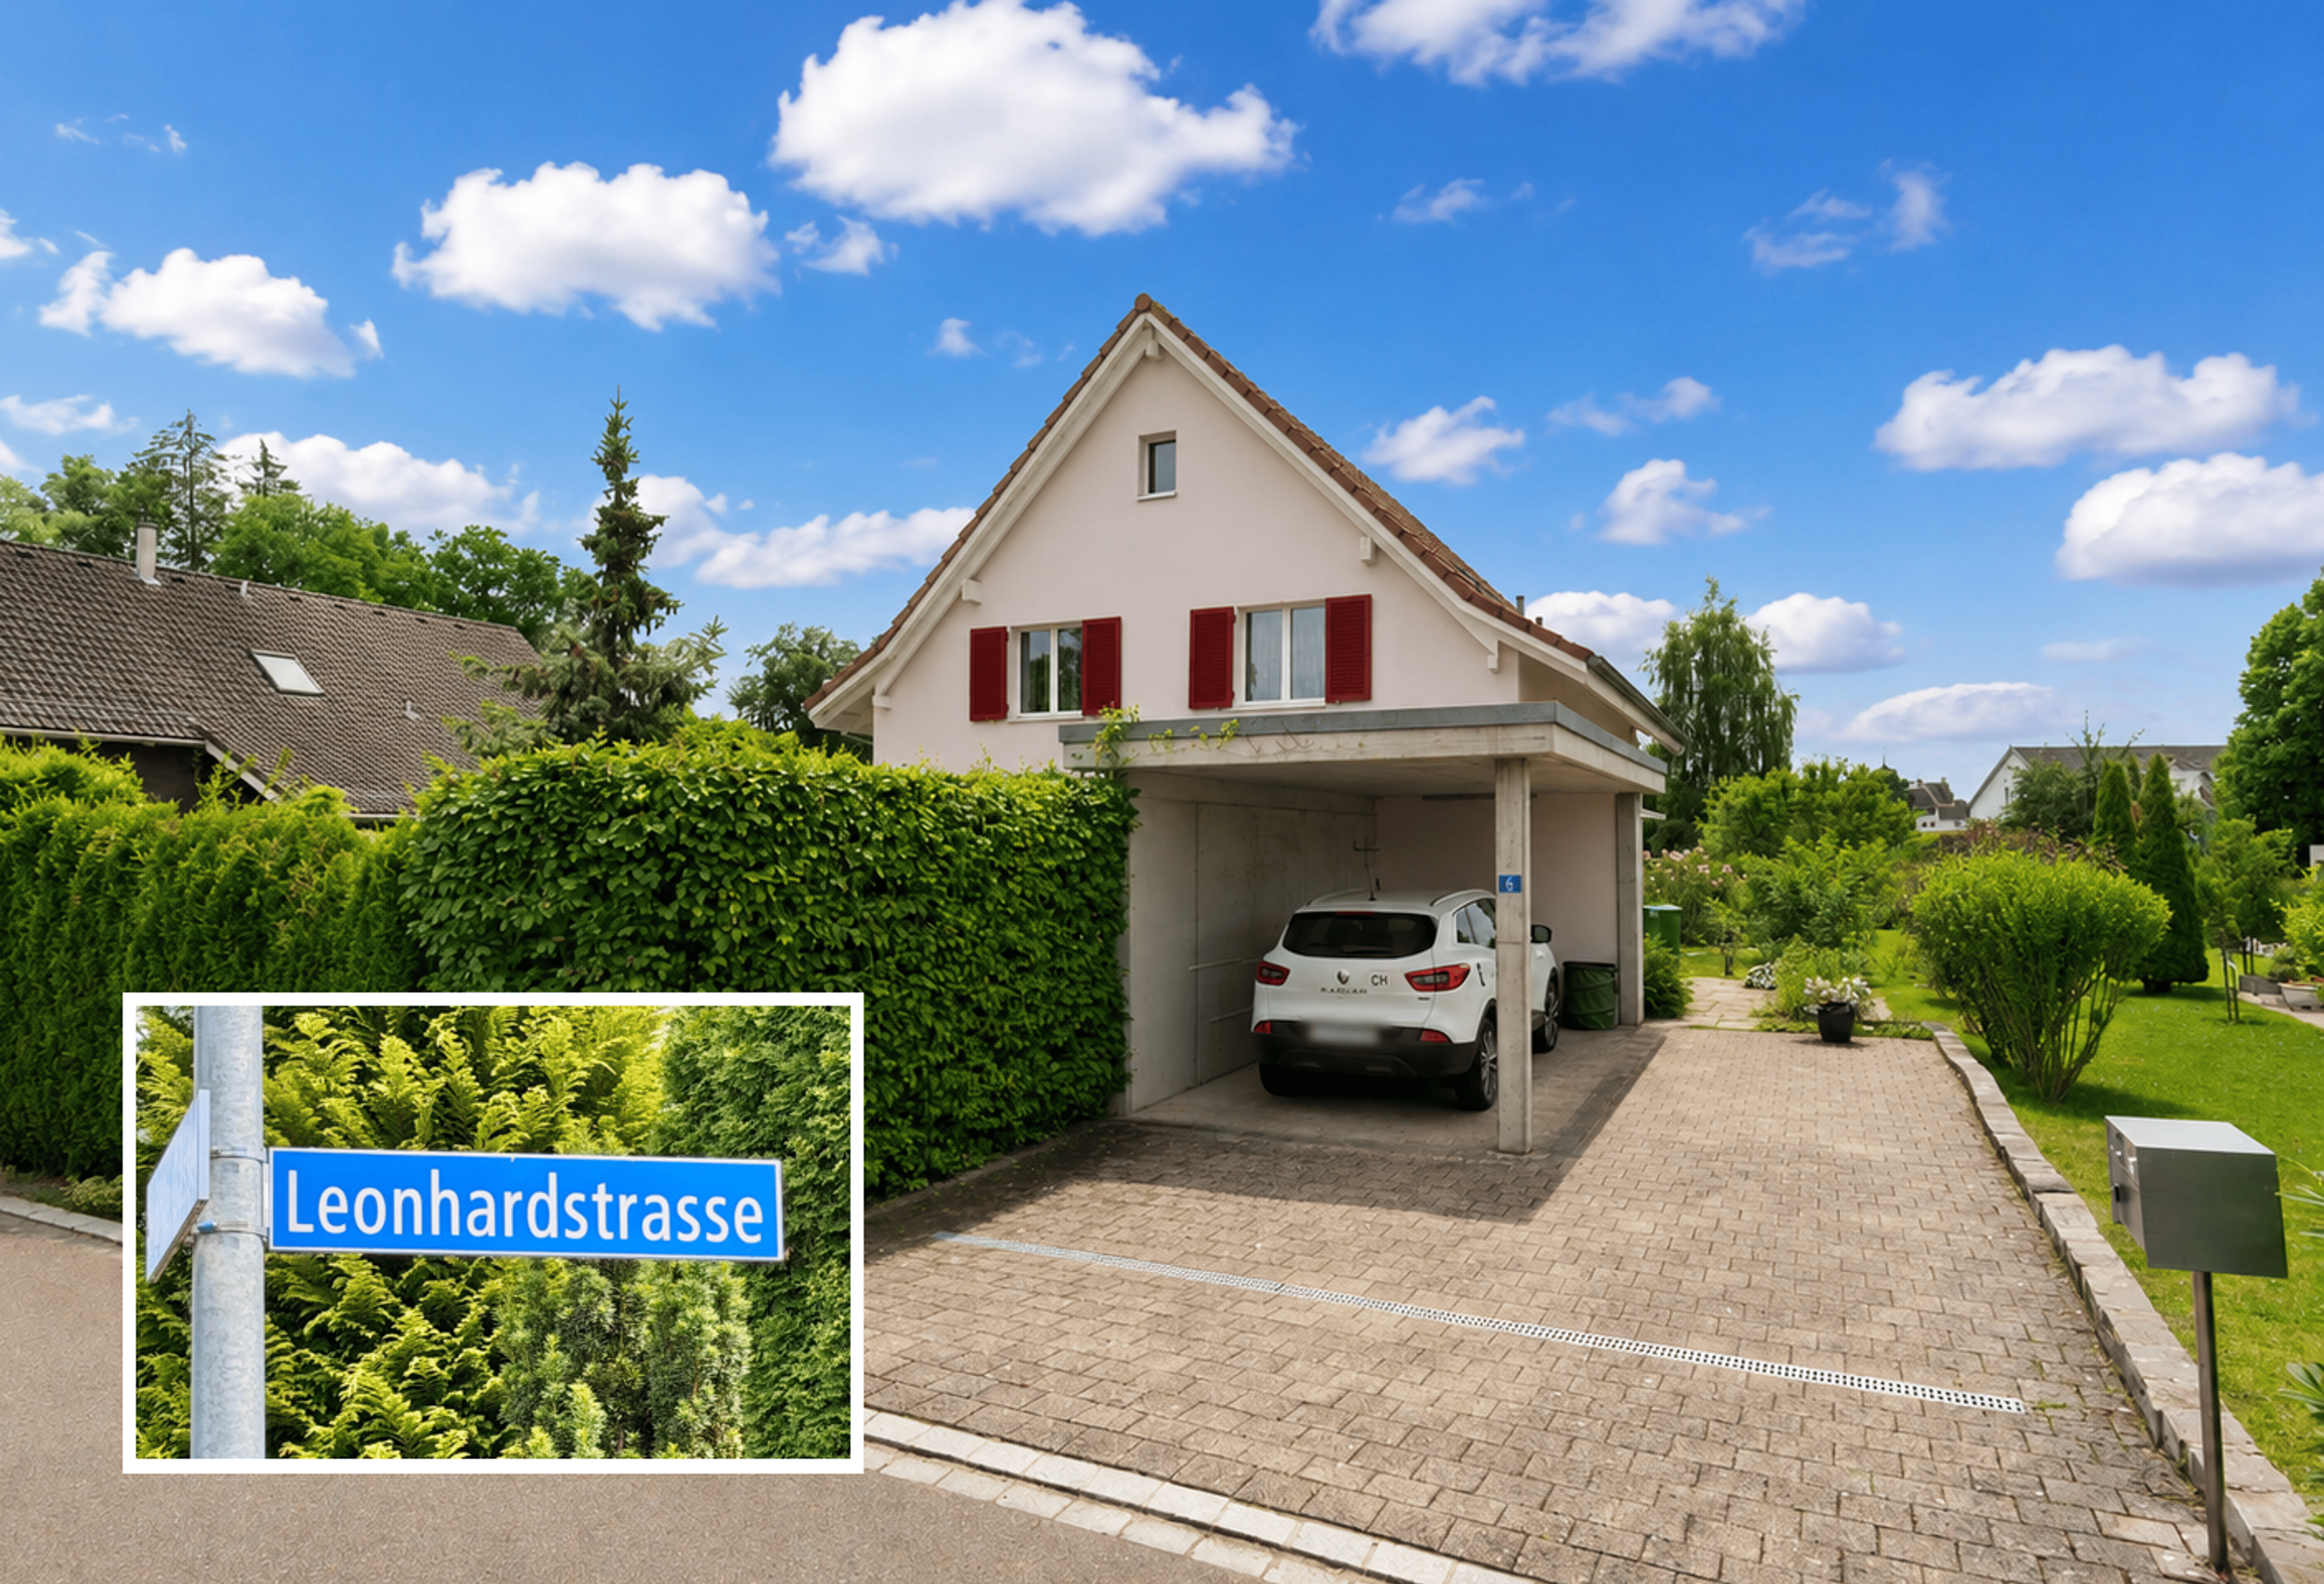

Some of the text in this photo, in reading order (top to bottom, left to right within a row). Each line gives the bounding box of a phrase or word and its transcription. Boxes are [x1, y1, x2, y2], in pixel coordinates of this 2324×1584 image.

[1505, 875, 1514, 892] 6
[1371, 974, 1388, 986] CH
[289, 1169, 763, 1243] Leonhardstrasse
